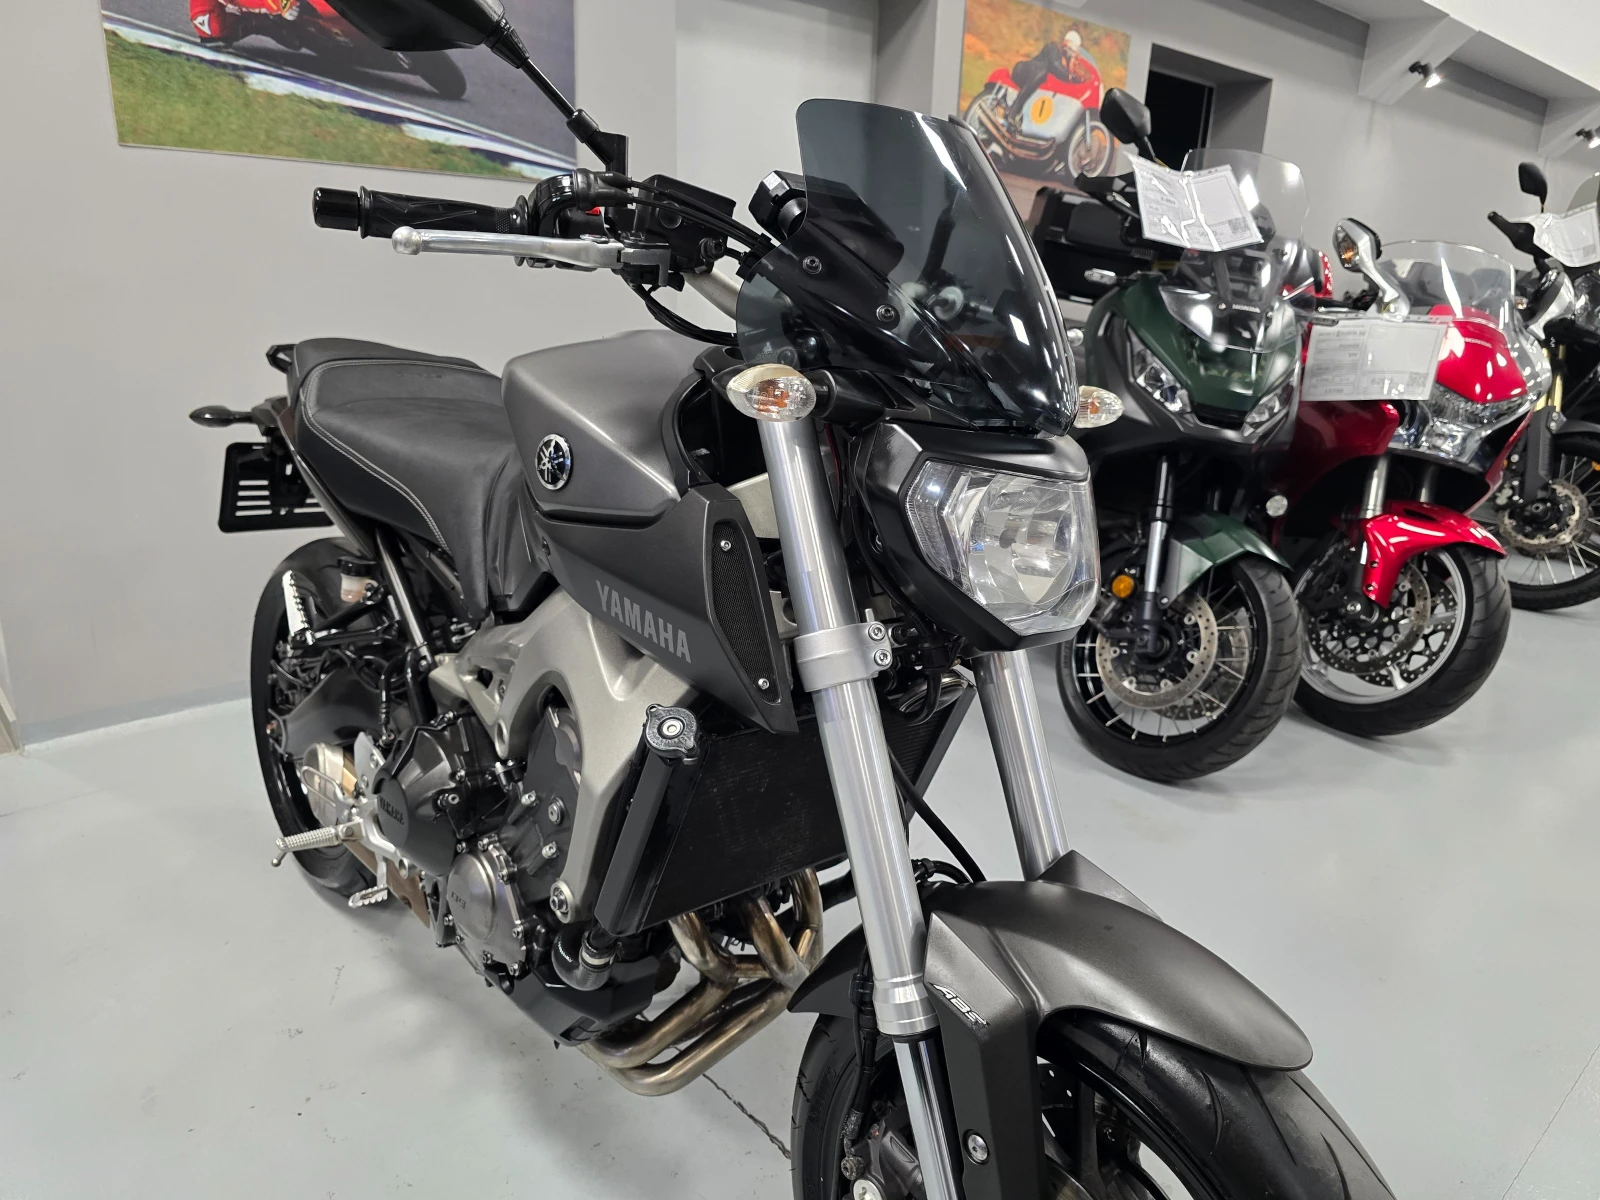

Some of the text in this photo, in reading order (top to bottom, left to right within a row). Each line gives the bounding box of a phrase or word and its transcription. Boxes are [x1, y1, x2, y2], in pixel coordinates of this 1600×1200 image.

[1038, 99, 1046, 118] 1
[596, 580, 691, 664] YAMAHA
[933, 984, 987, 1025] ABS
